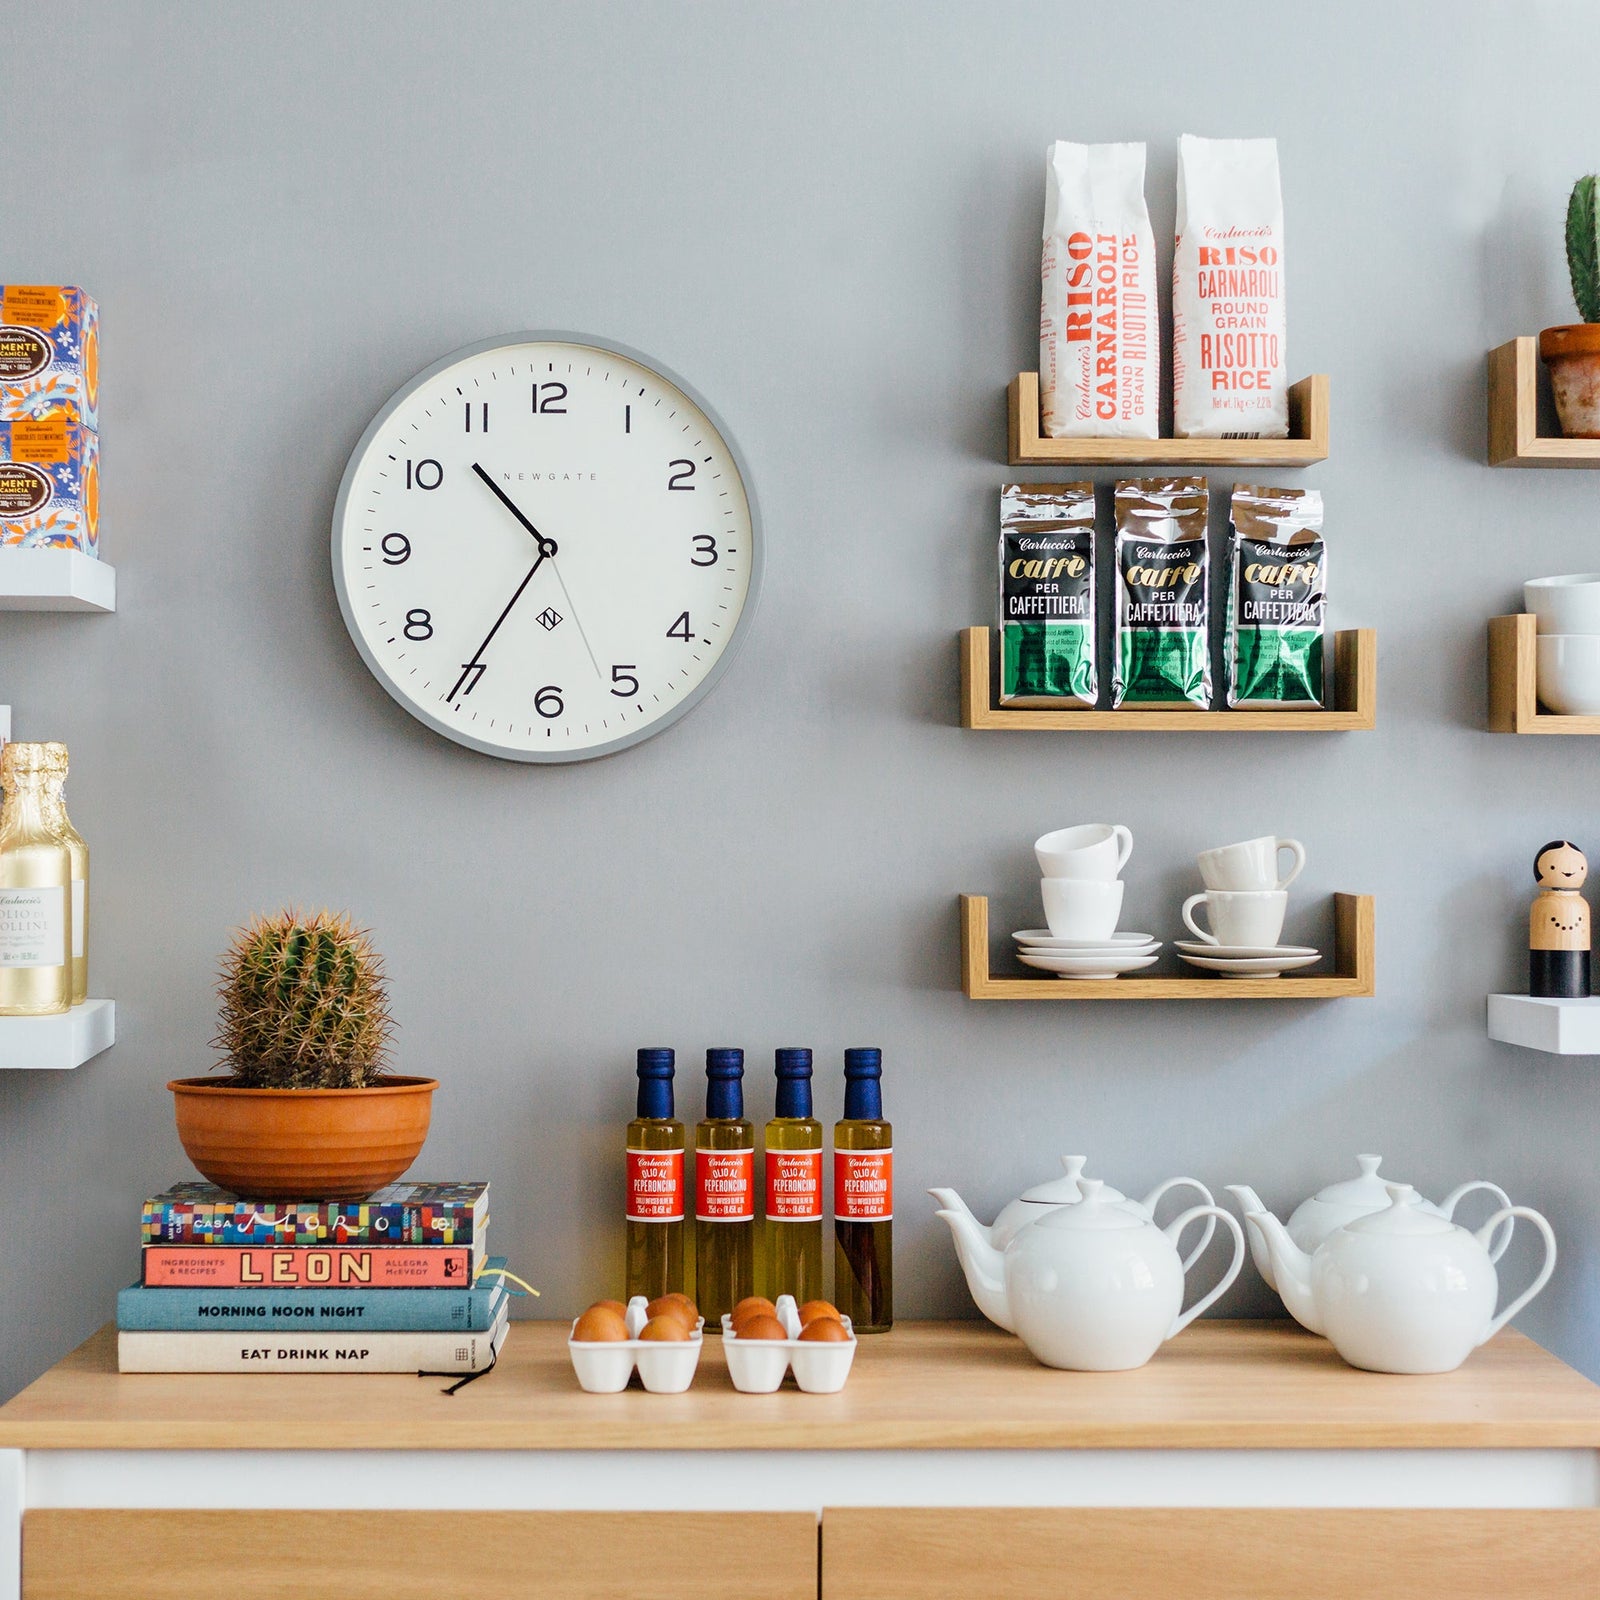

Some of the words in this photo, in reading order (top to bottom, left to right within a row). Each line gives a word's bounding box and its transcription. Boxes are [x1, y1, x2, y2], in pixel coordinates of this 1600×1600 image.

[1203, 224, 1273, 239] Carluccio's
[1122, 232, 1139, 288] RICE
[1198, 246, 1278, 267] RISO
[1066, 232, 1093, 344] RISO
[1198, 270, 1279, 299] CARNAROLI
[1212, 302, 1269, 315] ROUND
[1096, 234, 1117, 420] CARNAROLI
[1122, 293, 1147, 361] RISOTTO
[1215, 317, 1267, 329] GRAIN
[1, 343, 38, 351] MENTE
[1201, 333, 1279, 369] RISOTTO
[1075, 346, 1091, 421] Carluccio's
[1212, 371, 1272, 390] RICE
[532, 382, 567, 413] 12
[1122, 365, 1132, 420] ROUND
[1133, 367, 1144, 416] GRAIN
[465, 403, 488, 433] 11
[625, 405, 631, 433] 1
[1, 480, 38, 488] MENTE
[406, 459, 443, 490] 10
[668, 459, 696, 490] 2
[381, 533, 411, 565] 9
[691, 535, 718, 567] 3
[1019, 538, 1076, 551] Carluccio's
[1136, 546, 1190, 560] Carluccio's
[1254, 543, 1310, 558] Carluccio's
[1009, 555, 1085, 579] caffè
[1127, 563, 1200, 588] caffè
[1244, 562, 1318, 586] caffè
[1036, 583, 1059, 594] PER
[1151, 591, 1175, 601] PER
[1270, 589, 1293, 599] PER
[1009, 596, 1085, 615] CAFFETTIERA
[1127, 602, 1199, 622] CAFFETTIERA
[1244, 601, 1316, 621] CAFFETTIERA
[403, 608, 433, 641] 8
[666, 612, 696, 642] 4
[461, 664, 487, 695] 7
[610, 665, 639, 697] 5
[534, 686, 564, 718] 6
[642, 1168, 657, 1179] OLIO
[658, 1169, 667, 1178] AL
[712, 1168, 728, 1179] OLIO
[729, 1169, 738, 1178] AL
[781, 1168, 797, 1179] OLIO
[798, 1169, 808, 1178] AL
[853, 1168, 869, 1179] OLIO
[870, 1169, 878, 1178] AL
[634, 1179, 676, 1192] PEPERONCINO
[705, 1179, 747, 1192] PEPERONCINO
[773, 1179, 817, 1192] PEPERONCINO
[844, 1179, 887, 1192] PEPERONCINO
[194, 1220, 232, 1228] CASA
[237, 1210, 390, 1234] MORO
[161, 1259, 225, 1267] INGREDIENTS
[240, 1252, 373, 1284] LEON
[198, 1306, 266, 1317] MORNING
[271, 1306, 314, 1317] NOON
[320, 1306, 365, 1317] NIGHT
[241, 1349, 271, 1360] EAT
[277, 1349, 331, 1360] DRINK
[335, 1349, 370, 1360] NAP
